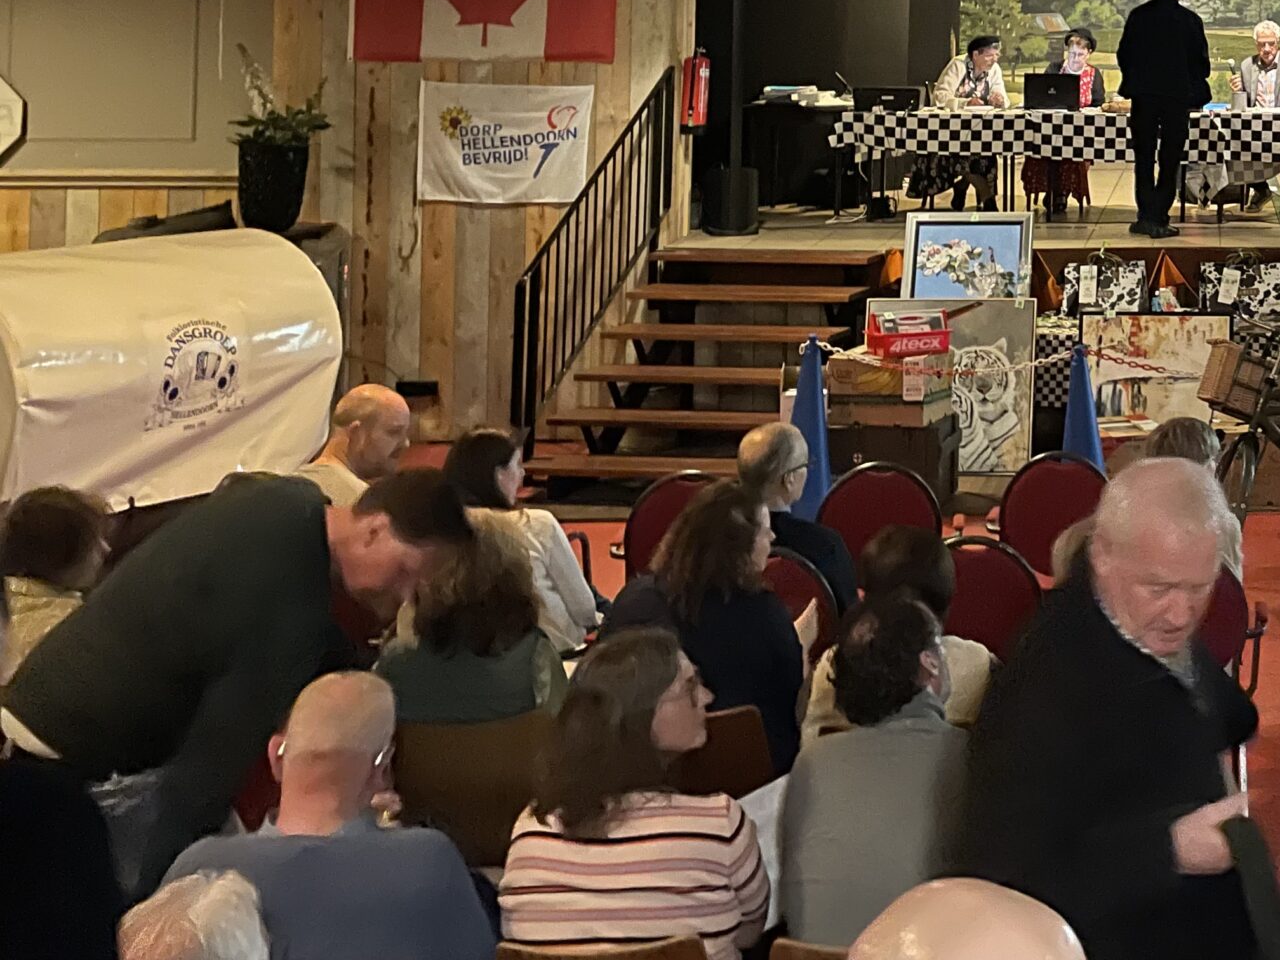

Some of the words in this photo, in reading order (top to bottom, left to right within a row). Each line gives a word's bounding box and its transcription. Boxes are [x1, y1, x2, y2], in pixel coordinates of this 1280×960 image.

[459, 123, 502, 138] DORP
[461, 127, 577, 151] HELLENDOORN
[462, 148, 529, 166] BEVRIJD!
[164, 326, 237, 370] DANSGROEP
[889, 337, 941, 353] 4tecx
